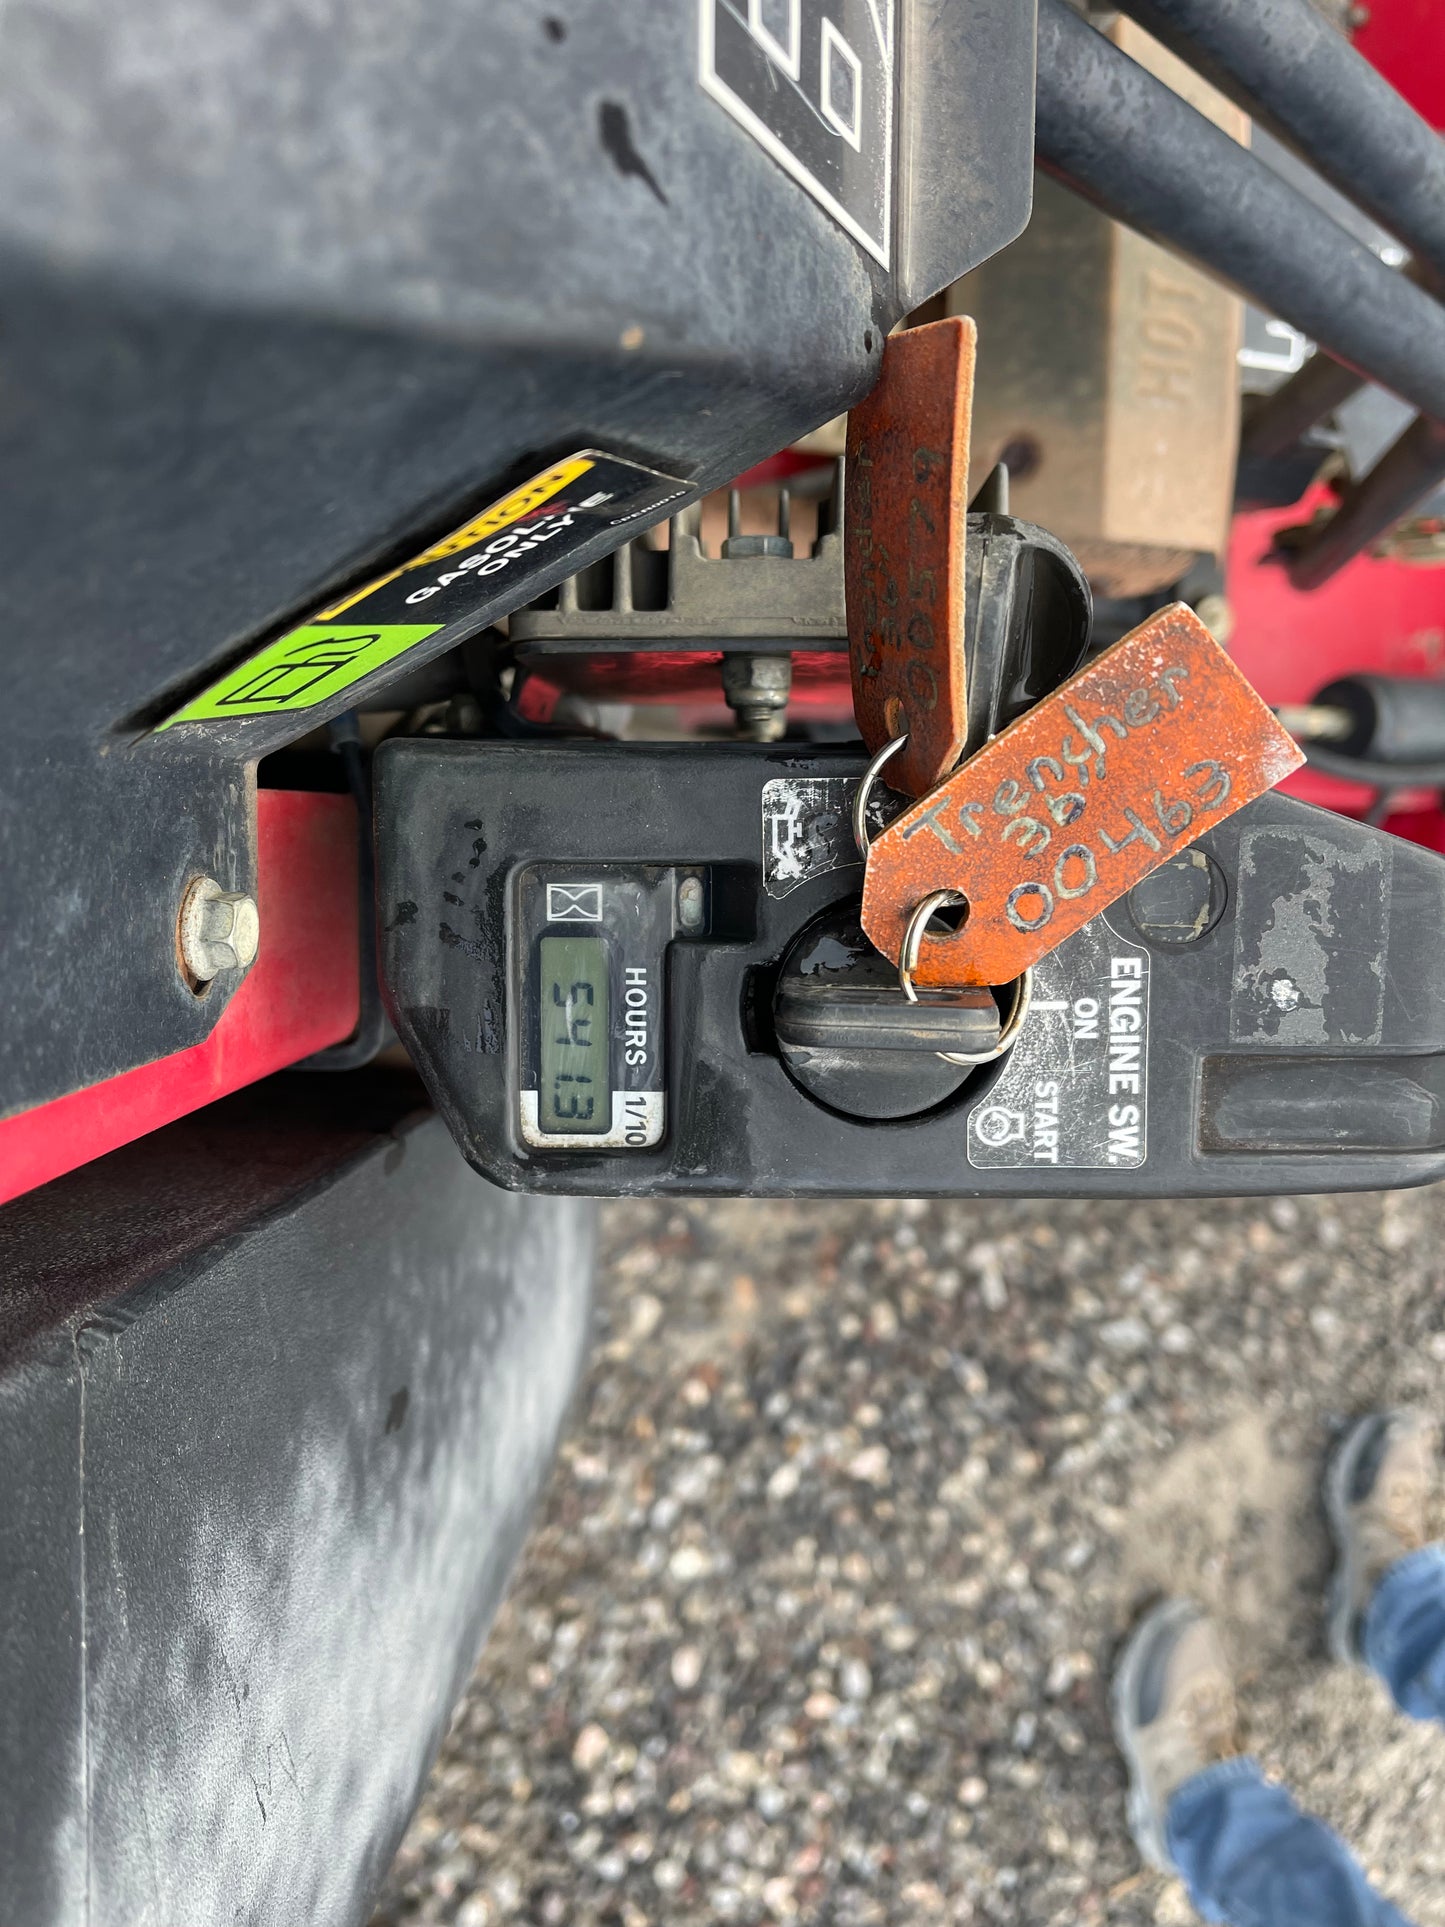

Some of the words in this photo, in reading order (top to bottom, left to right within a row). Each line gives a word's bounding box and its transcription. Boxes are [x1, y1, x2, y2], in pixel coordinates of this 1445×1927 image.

[1136, 269, 1204, 403] HOT
[477, 512, 576, 577] ONLY
[902, 666, 1190, 855] Trencher
[1006, 759, 1232, 933] 00463
[553, 981, 594, 1121] 541.3
[625, 967, 647, 1066] HOURS
[1074, 998, 1100, 1040] ON
[1109, 957, 1142, 1095] ENGINE
[625, 1096, 647, 1146] 1/10
[1033, 1080, 1058, 1164] START
[1108, 1104, 1141, 1164] SW.
